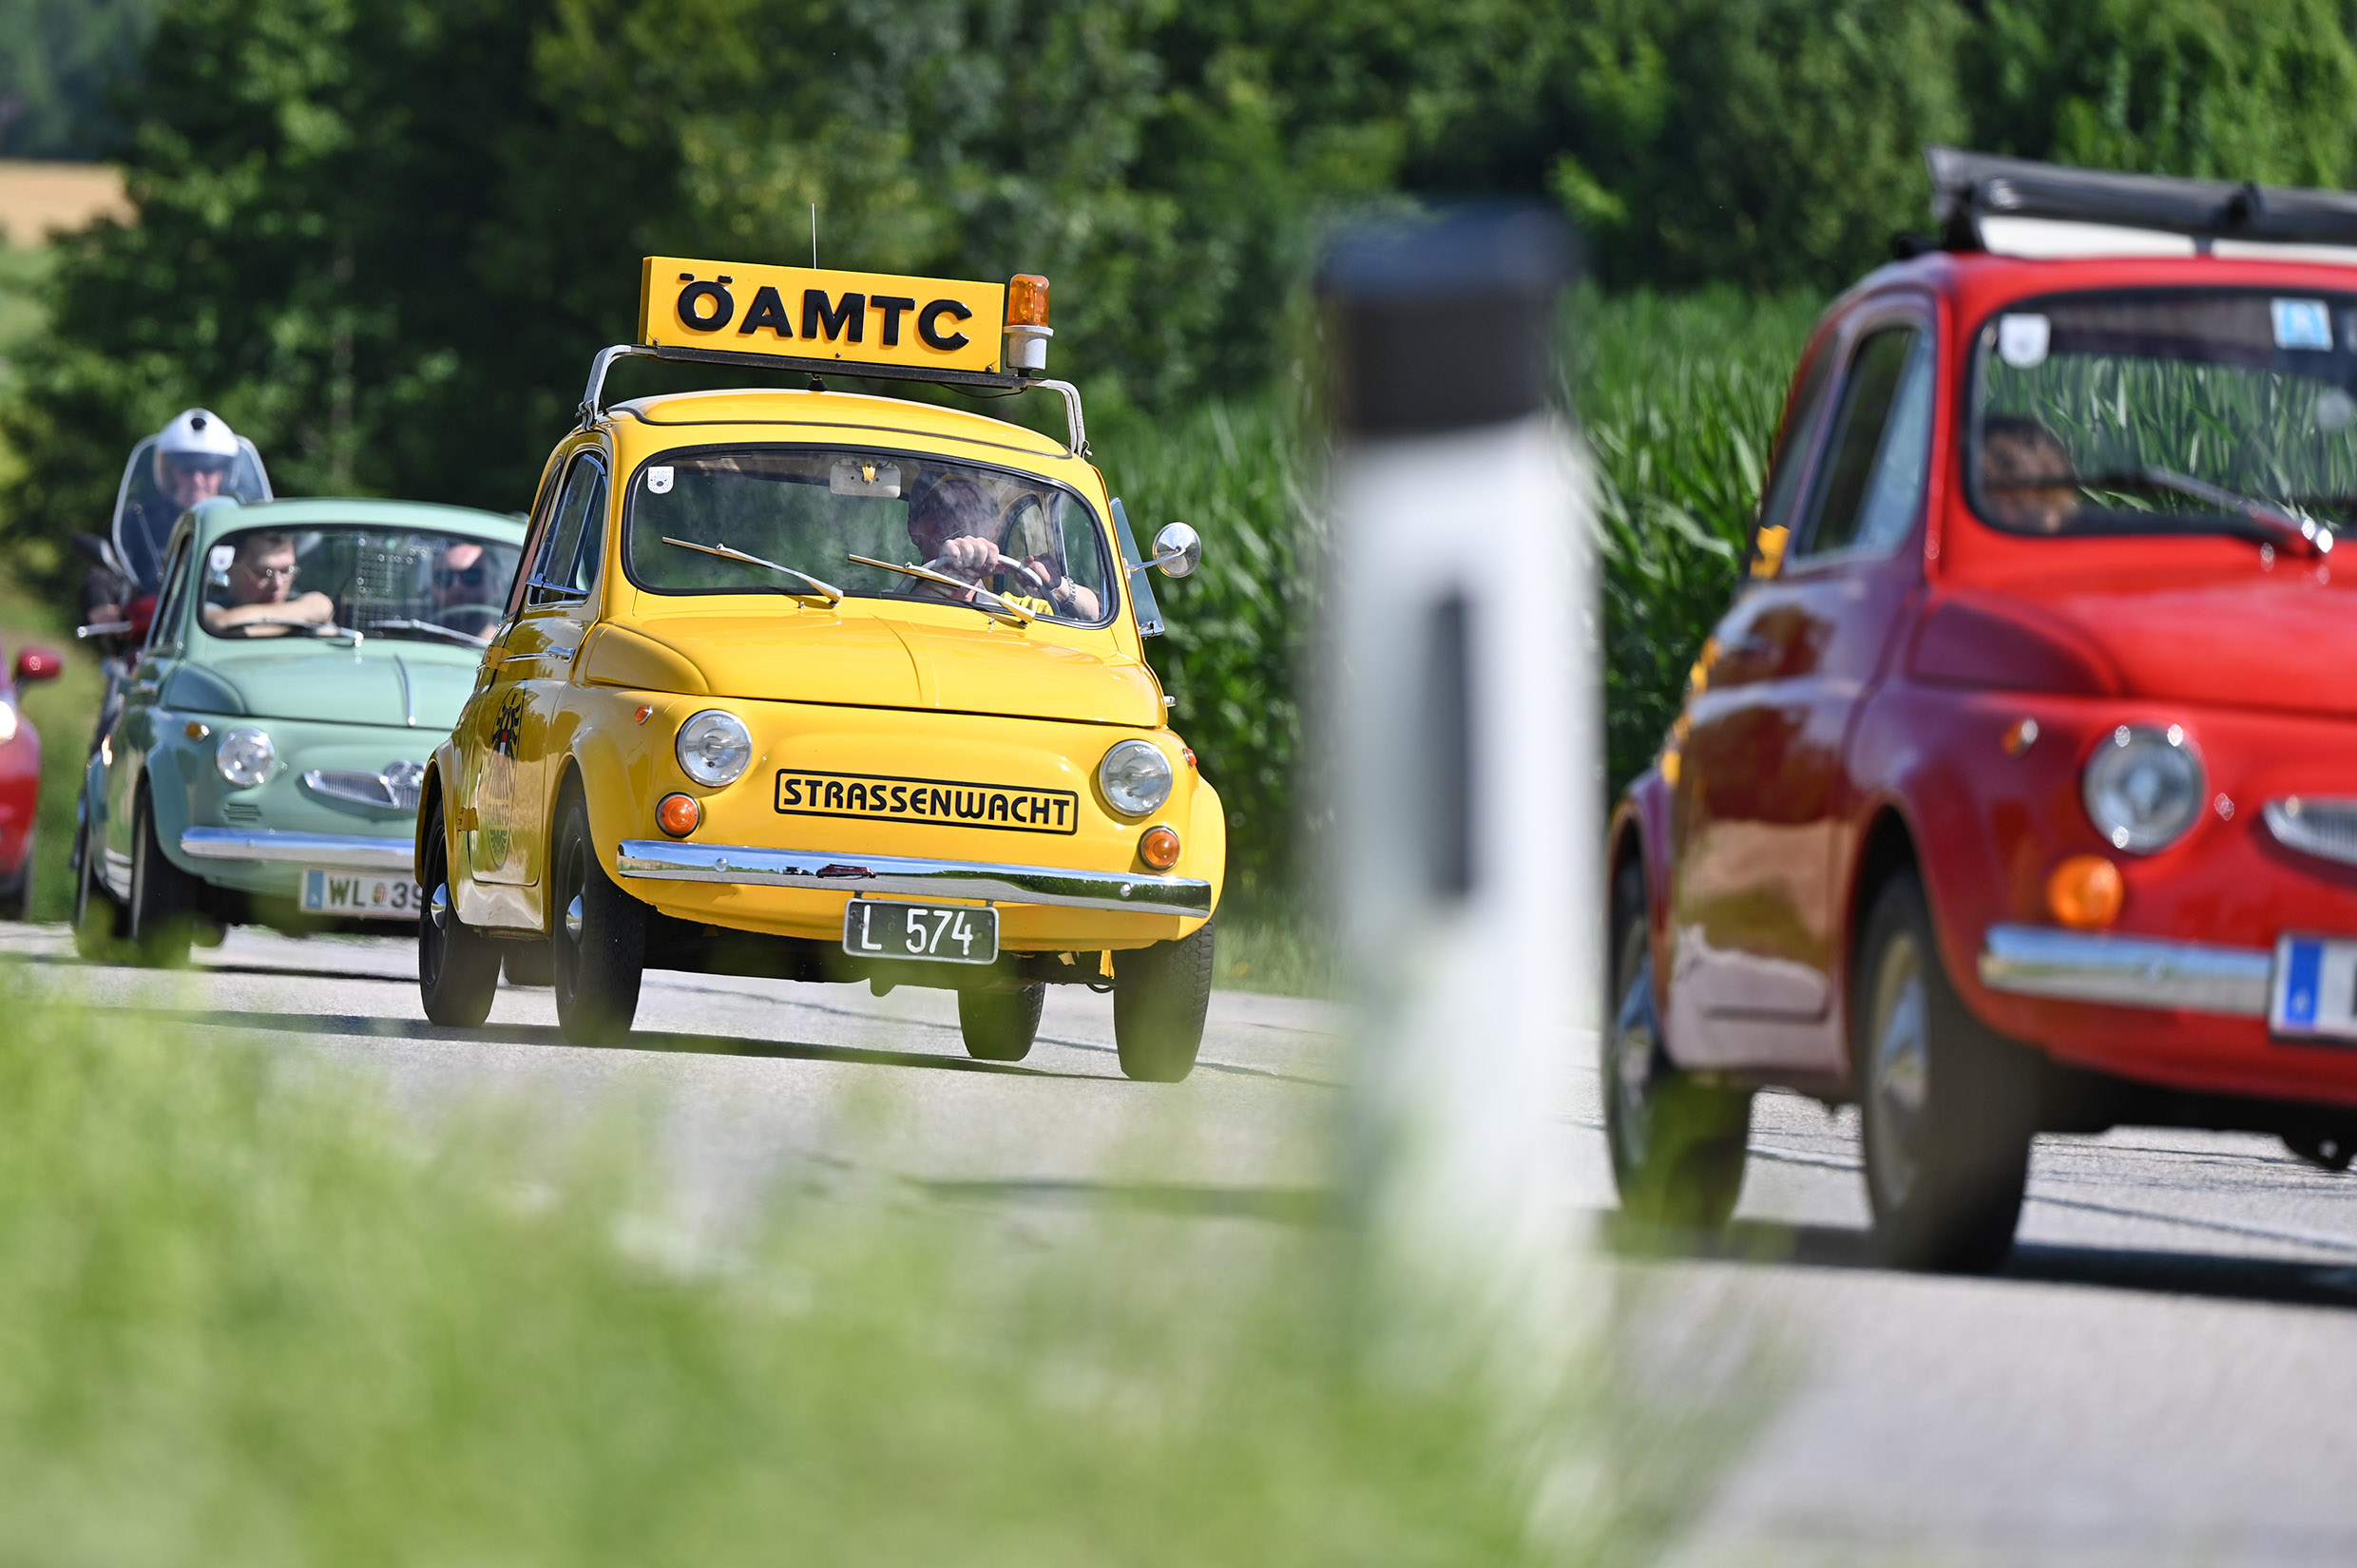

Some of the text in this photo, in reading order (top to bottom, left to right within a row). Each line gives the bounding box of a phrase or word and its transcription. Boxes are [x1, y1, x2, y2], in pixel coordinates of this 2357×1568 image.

[678, 273, 973, 351] ÖAMTC
[783, 777, 1070, 826] STRASSENWACHT
[329, 876, 366, 907] WL
[861, 905, 973, 956] L 574
